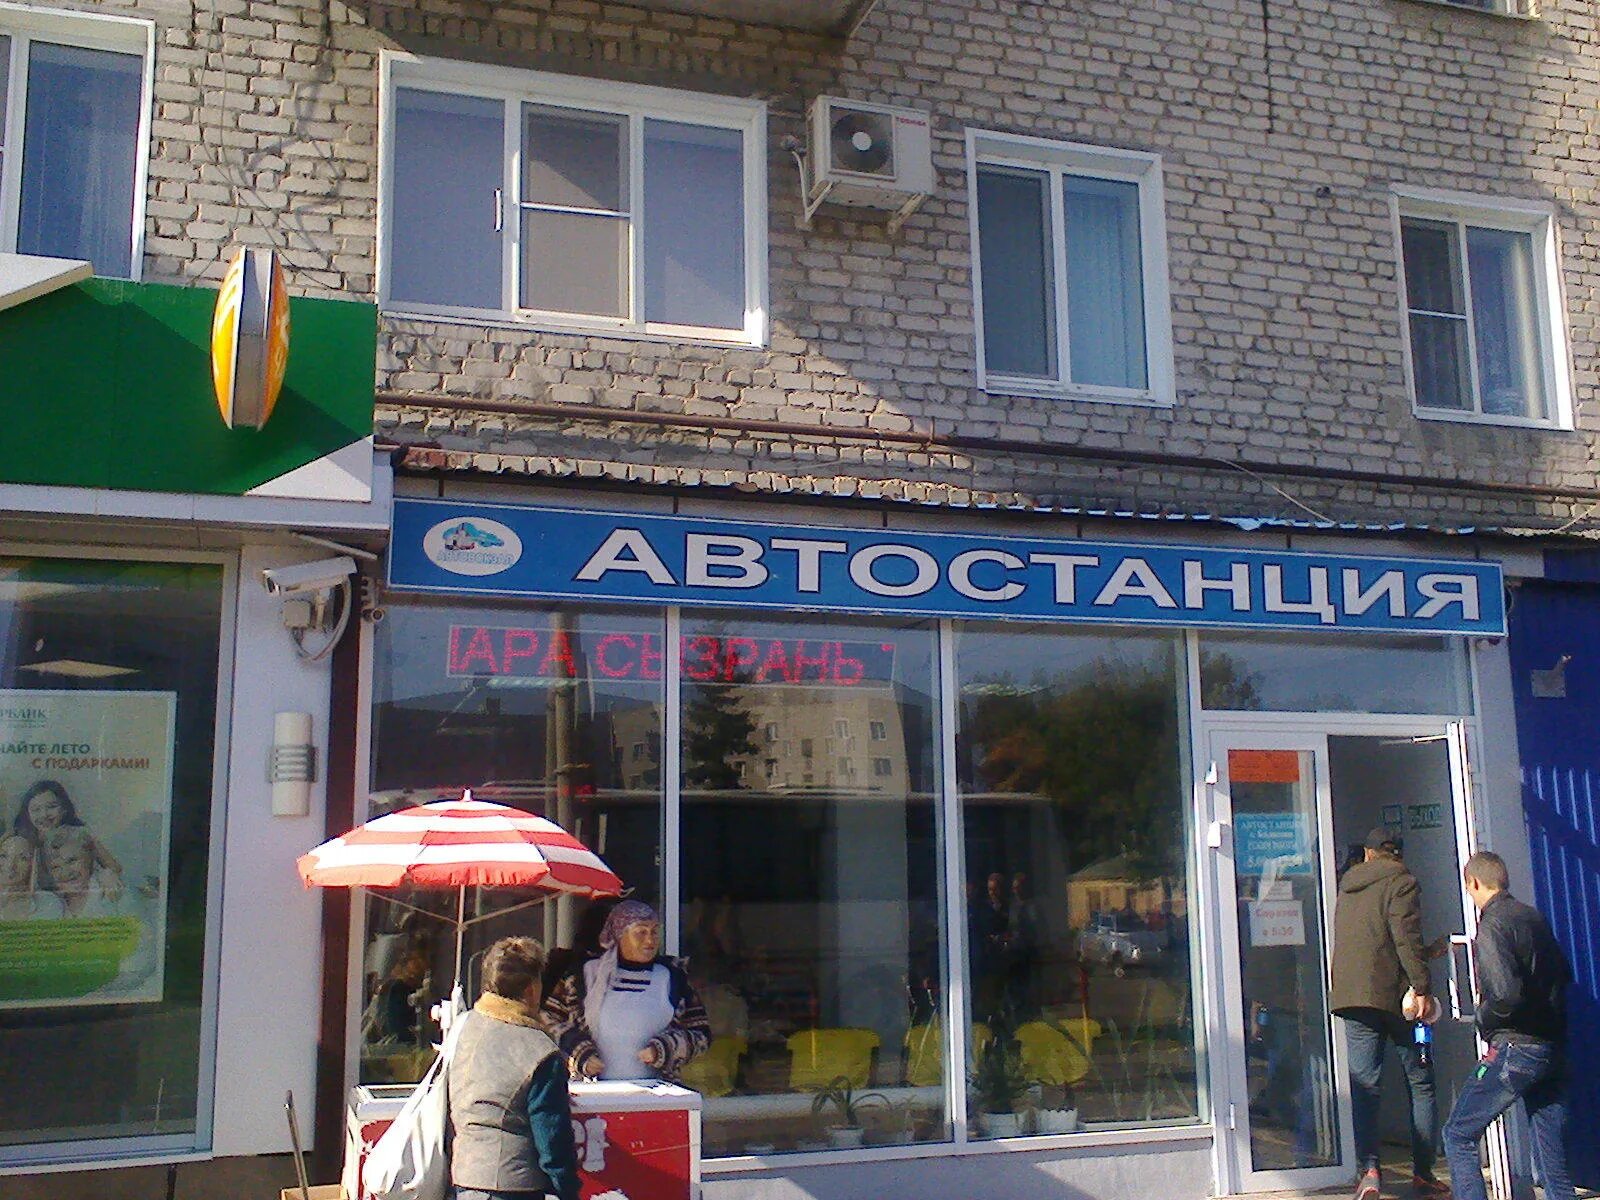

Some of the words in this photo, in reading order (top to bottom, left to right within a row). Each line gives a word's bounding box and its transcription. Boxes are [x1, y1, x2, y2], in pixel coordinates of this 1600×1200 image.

[574, 528, 1480, 625] АВТОСТАНЦИЯ
[596, 632, 865, 686] СЫЗРАНЬ
[32, 758, 42, 769] С
[46, 757, 150, 771] ПОДАРКАМИ!
[51, 743, 91, 755] ЛЕТО
